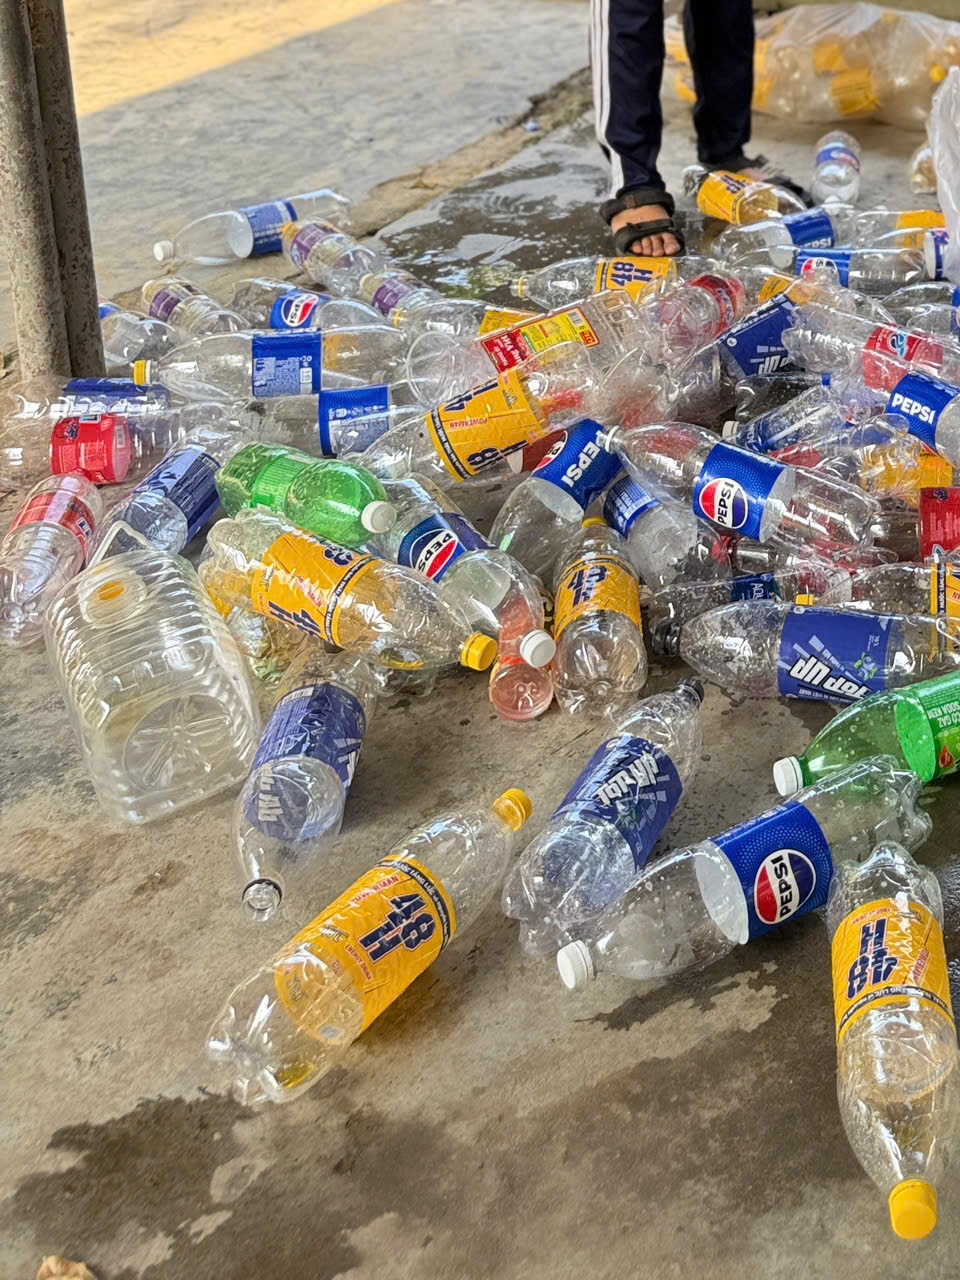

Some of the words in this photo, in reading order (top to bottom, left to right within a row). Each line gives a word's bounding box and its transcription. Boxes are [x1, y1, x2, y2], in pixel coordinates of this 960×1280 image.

[611, 262, 635, 287] 48
[449, 417, 489, 429] POWERMAN
[891, 393, 936, 424] PEPSI
[718, 481, 735, 525] PEPSI
[417, 532, 453, 573] PEPS
[789, 655, 831, 689] UP
[822, 675, 873, 701] TOP
[925, 705, 943, 720] KEM
[936, 714, 953, 728] GAZ
[941, 700, 960, 715] SODA
[594, 768, 638, 807] TOP
[409, 869, 426, 885] TĂNG
[422, 882, 436, 896] LỰC
[770, 854, 793, 919] PEPSI
[385, 892, 436, 952] 48
[860, 918, 888, 956] H
[358, 919, 404, 965] H
[847, 946, 898, 1000] 48
